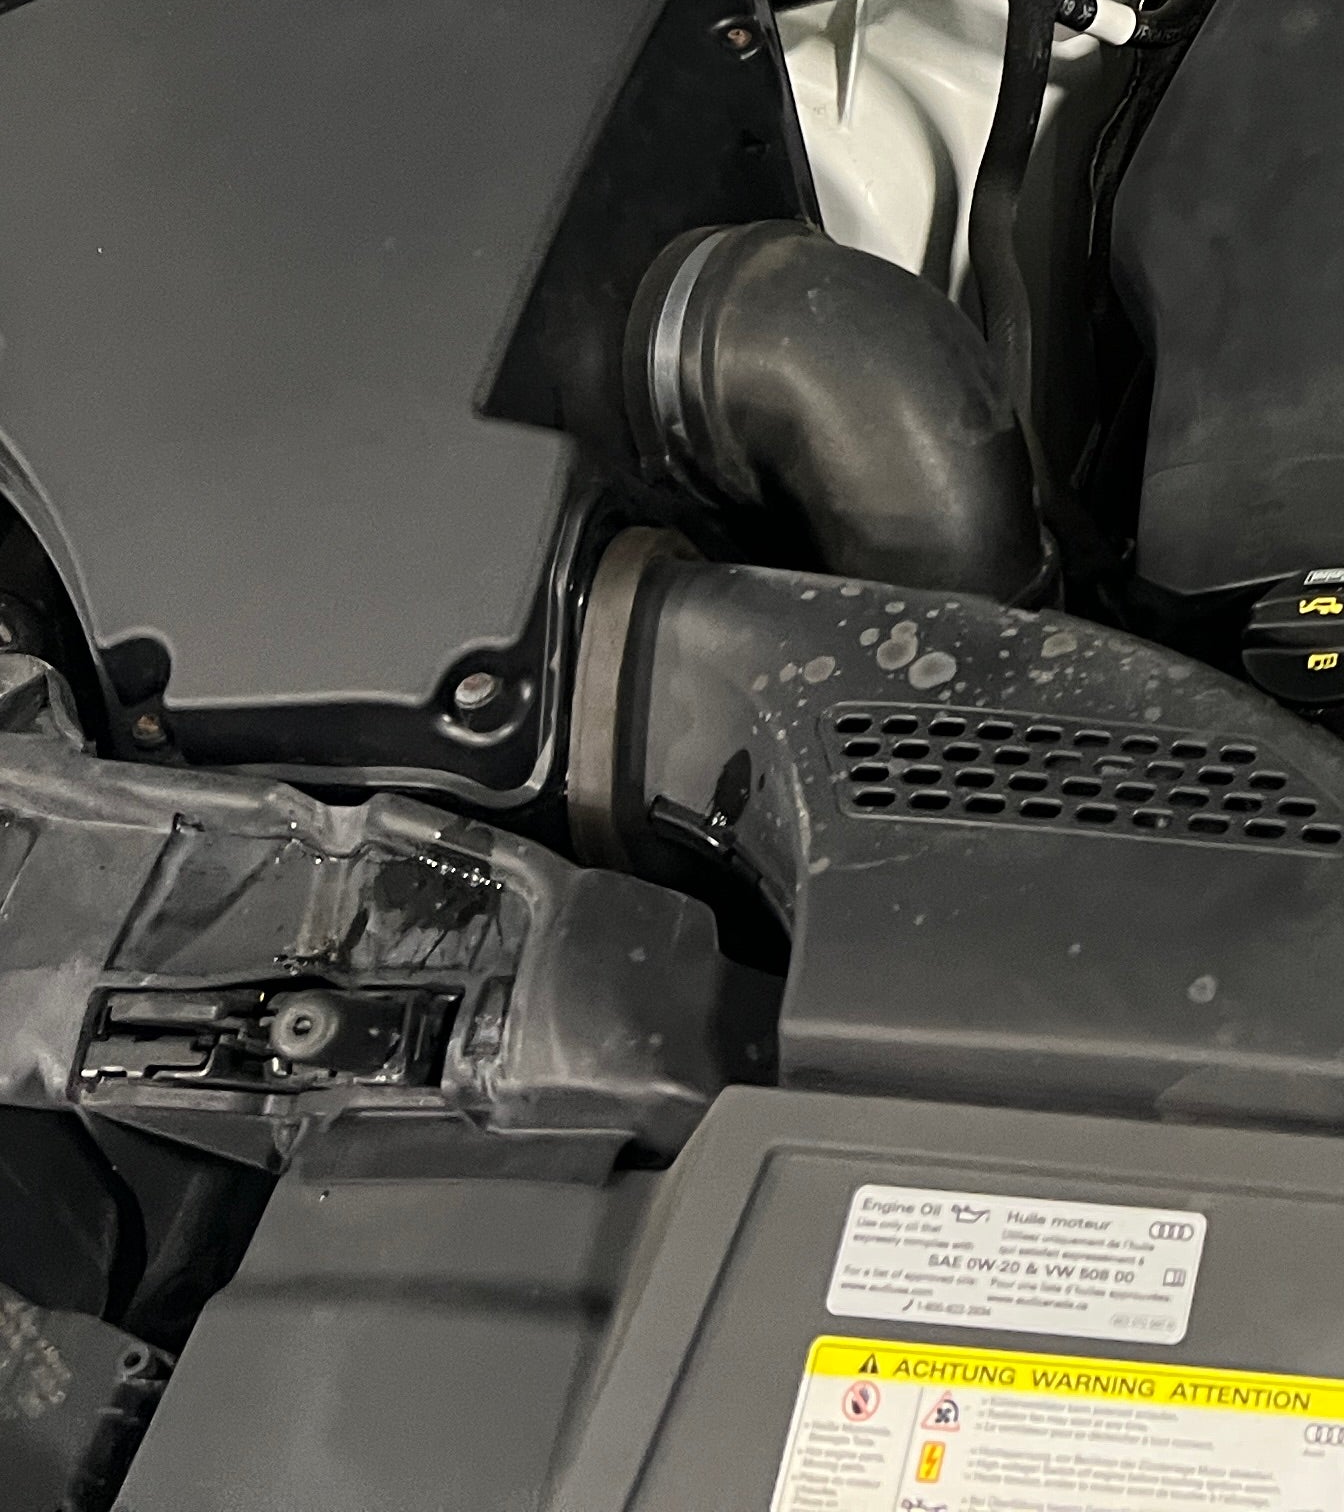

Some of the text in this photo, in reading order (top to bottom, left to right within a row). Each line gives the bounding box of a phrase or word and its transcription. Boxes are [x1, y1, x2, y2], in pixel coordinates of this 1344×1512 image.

[862, 1198, 942, 1217] Engine Oil
[1007, 1210, 1113, 1231] Huile moteur
[928, 1254, 962, 1268] SAE
[1046, 1264, 1075, 1278] VW
[1115, 1271, 1135, 1284] 00
[893, 1359, 1312, 1411] ACHTUNG WARNING ATTENTION
